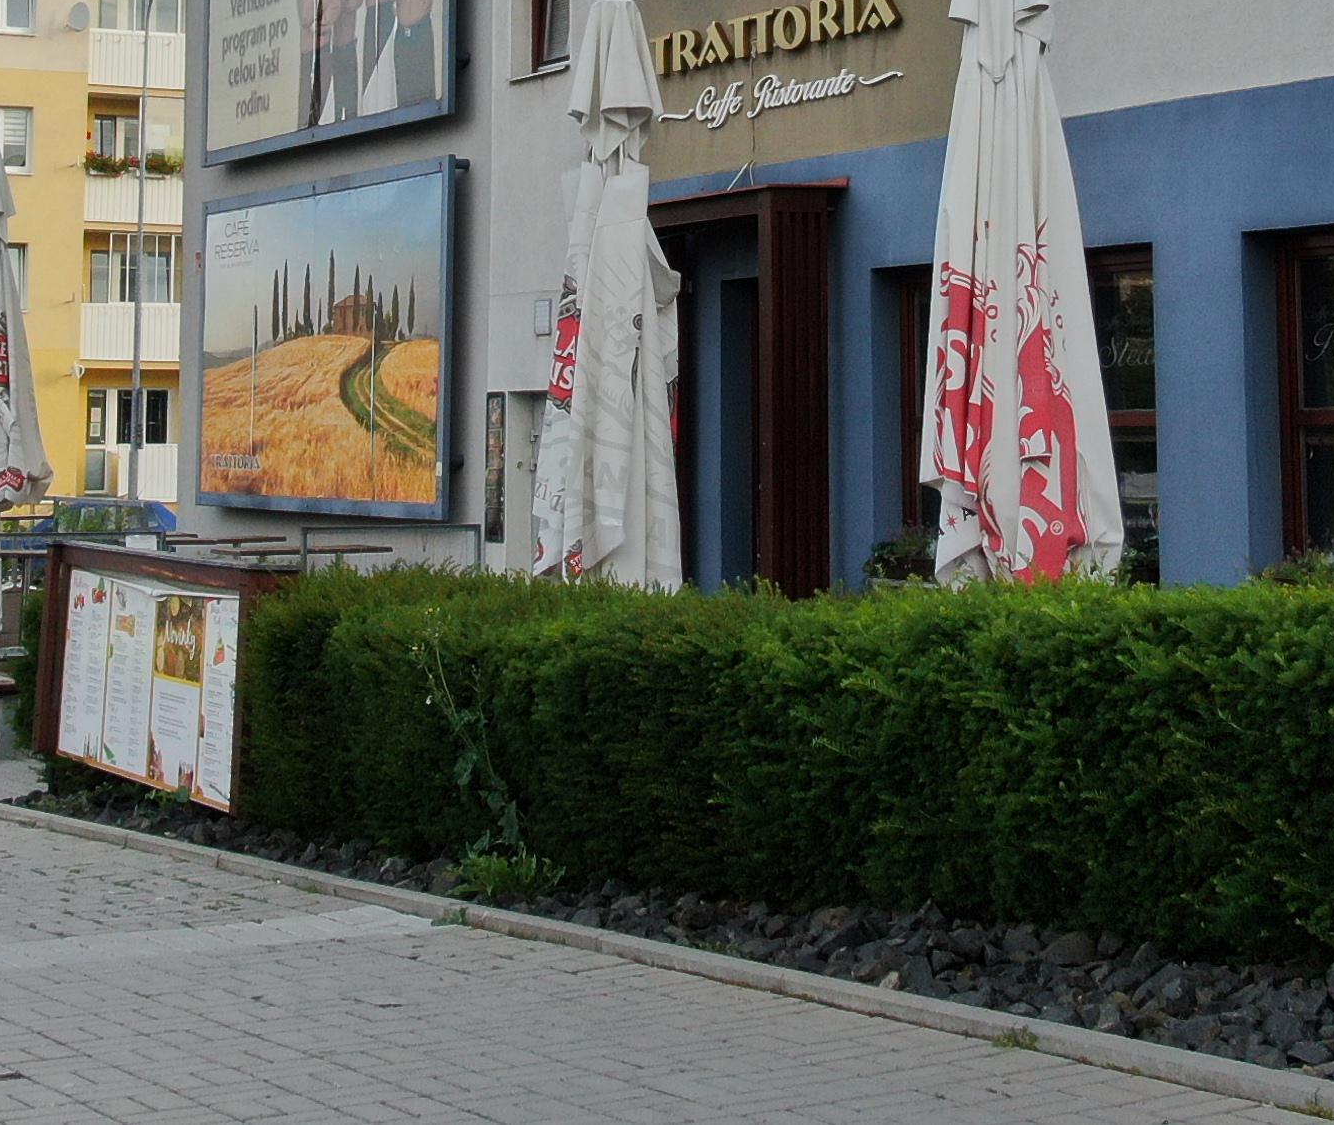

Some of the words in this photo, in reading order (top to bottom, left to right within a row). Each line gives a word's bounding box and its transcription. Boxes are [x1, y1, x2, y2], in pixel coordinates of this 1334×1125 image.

[222, 24, 267, 61] program
[268, 17, 289, 47] pro
[228, 58, 257, 86] celou
[258, 47, 281, 77] Vaší
[235, 90, 271, 119] rodinu
[747, 68, 857, 119] Ristorante
[224, 210, 251, 238] CAFÉ
[214, 239, 260, 260] RESERVA
[210, 453, 261, 470] TRATTORIA
